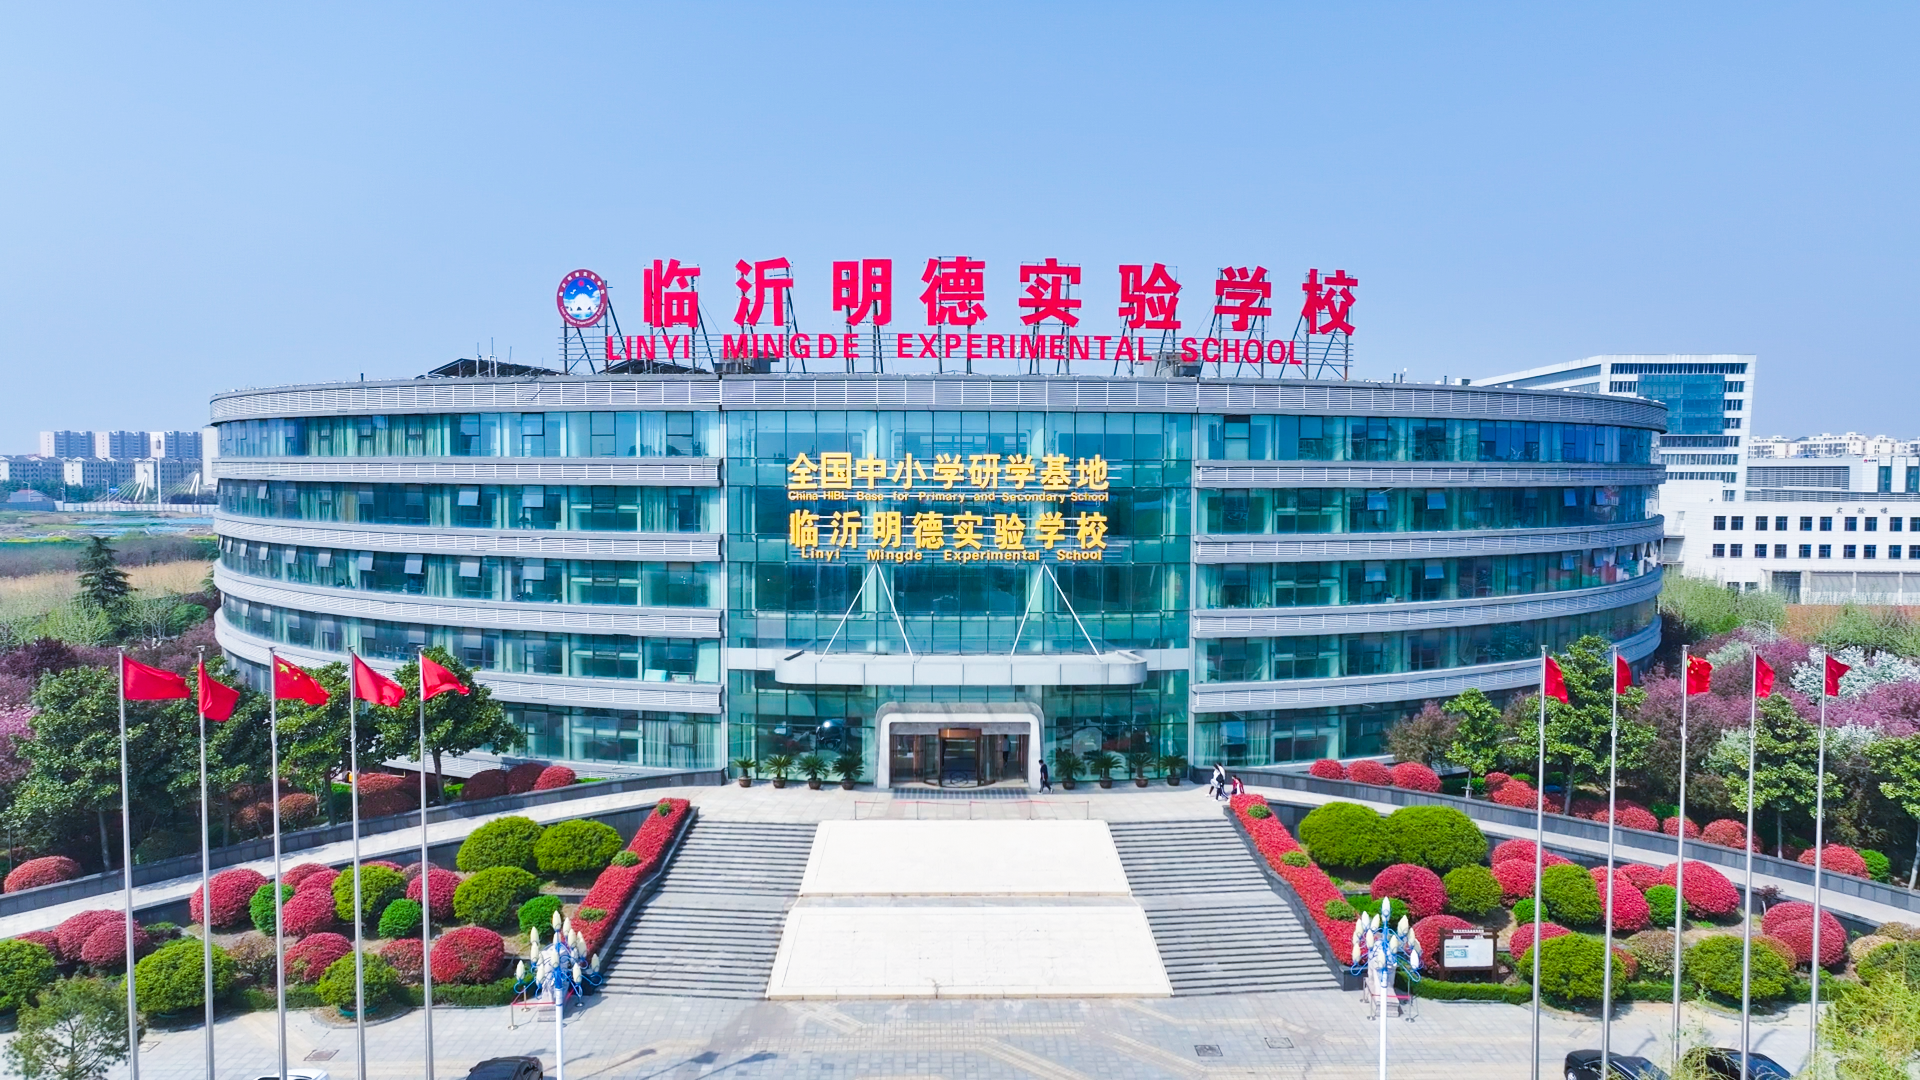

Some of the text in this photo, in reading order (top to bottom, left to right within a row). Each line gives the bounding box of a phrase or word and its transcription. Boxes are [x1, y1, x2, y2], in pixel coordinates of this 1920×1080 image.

[643, 256, 1359, 335] 临沂明德实验学校
[606, 333, 1303, 365] LINYI MINGDE EXPERIMENTAL SCHOOL
[787, 452, 1110, 490] 全国中小学研学基地
[788, 490, 1109, 504] China HIBL Base for Primary and Secondary School
[789, 509, 1108, 550] 临沂明德实验学校
[801, 548, 1102, 563] Linyi Mingde Experimental School
